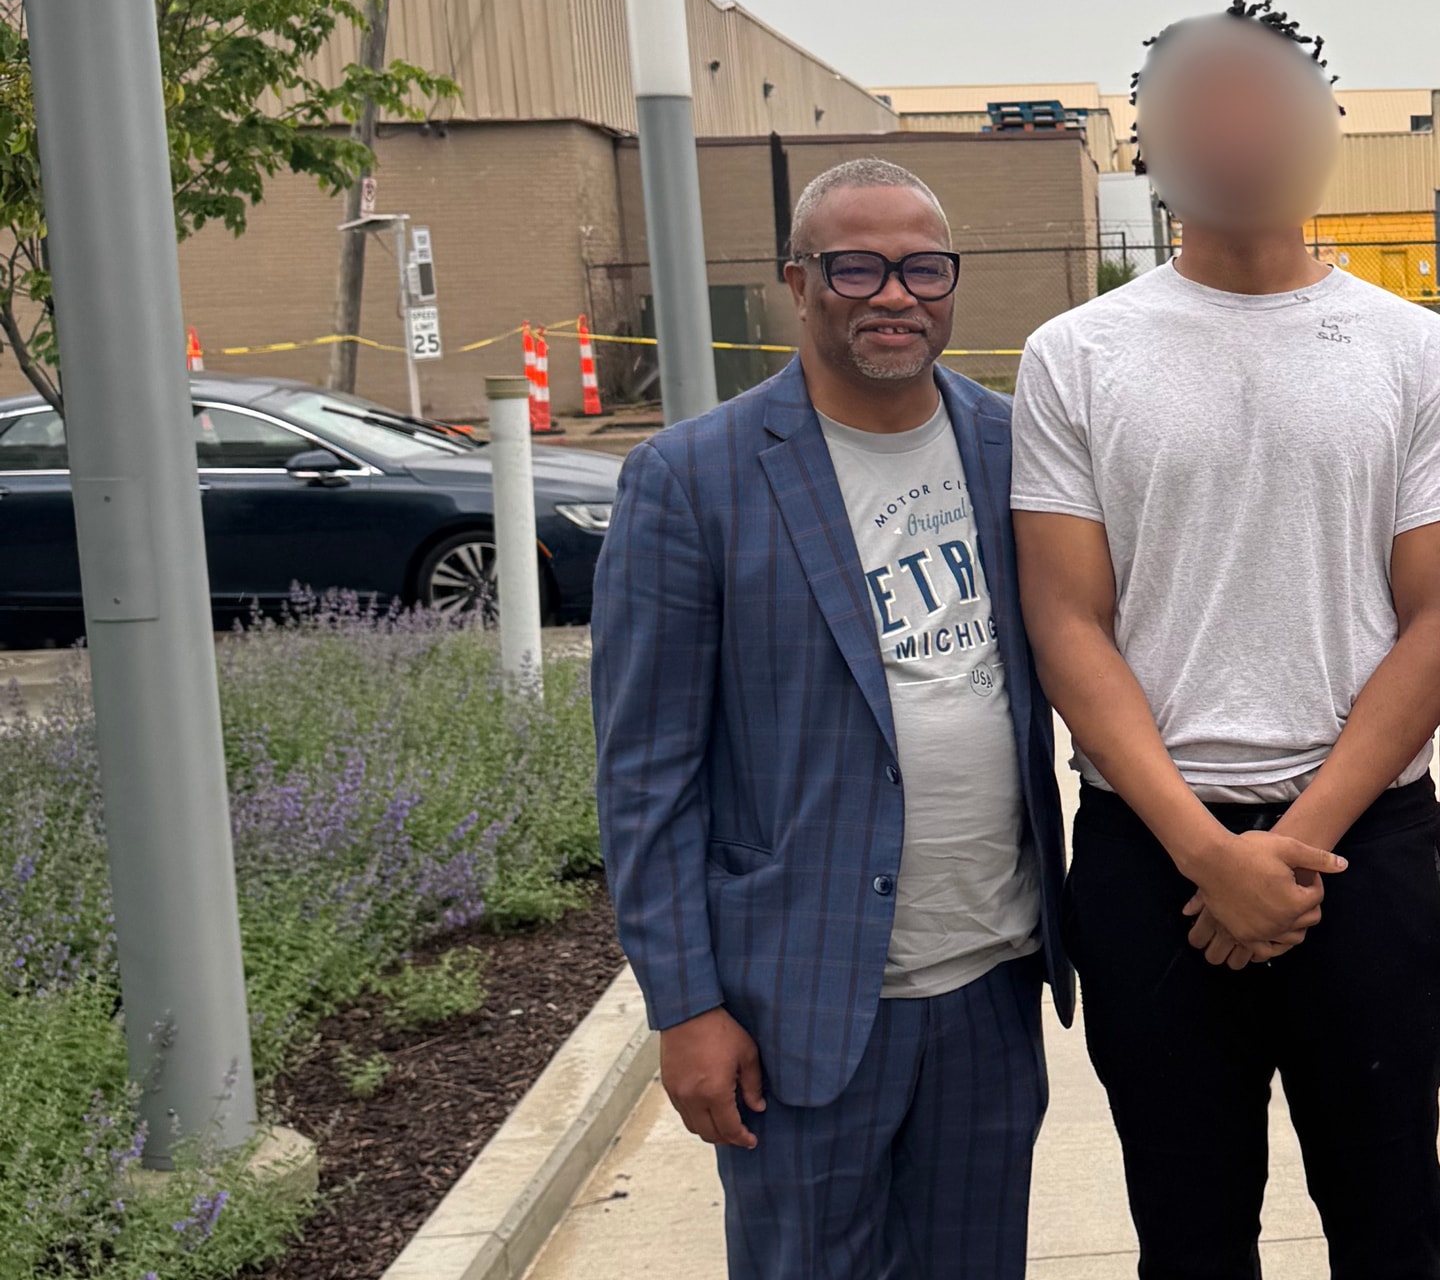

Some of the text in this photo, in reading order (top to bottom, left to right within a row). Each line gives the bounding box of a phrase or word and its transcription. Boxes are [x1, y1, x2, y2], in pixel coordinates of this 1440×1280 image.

[412, 311, 437, 321] SPEED
[415, 322, 435, 331] LIMIT
[414, 334, 439, 354] 25
[874, 483, 931, 529] MOTOR
[907, 497, 969, 537] Original
[972, 669, 994, 689] USA
